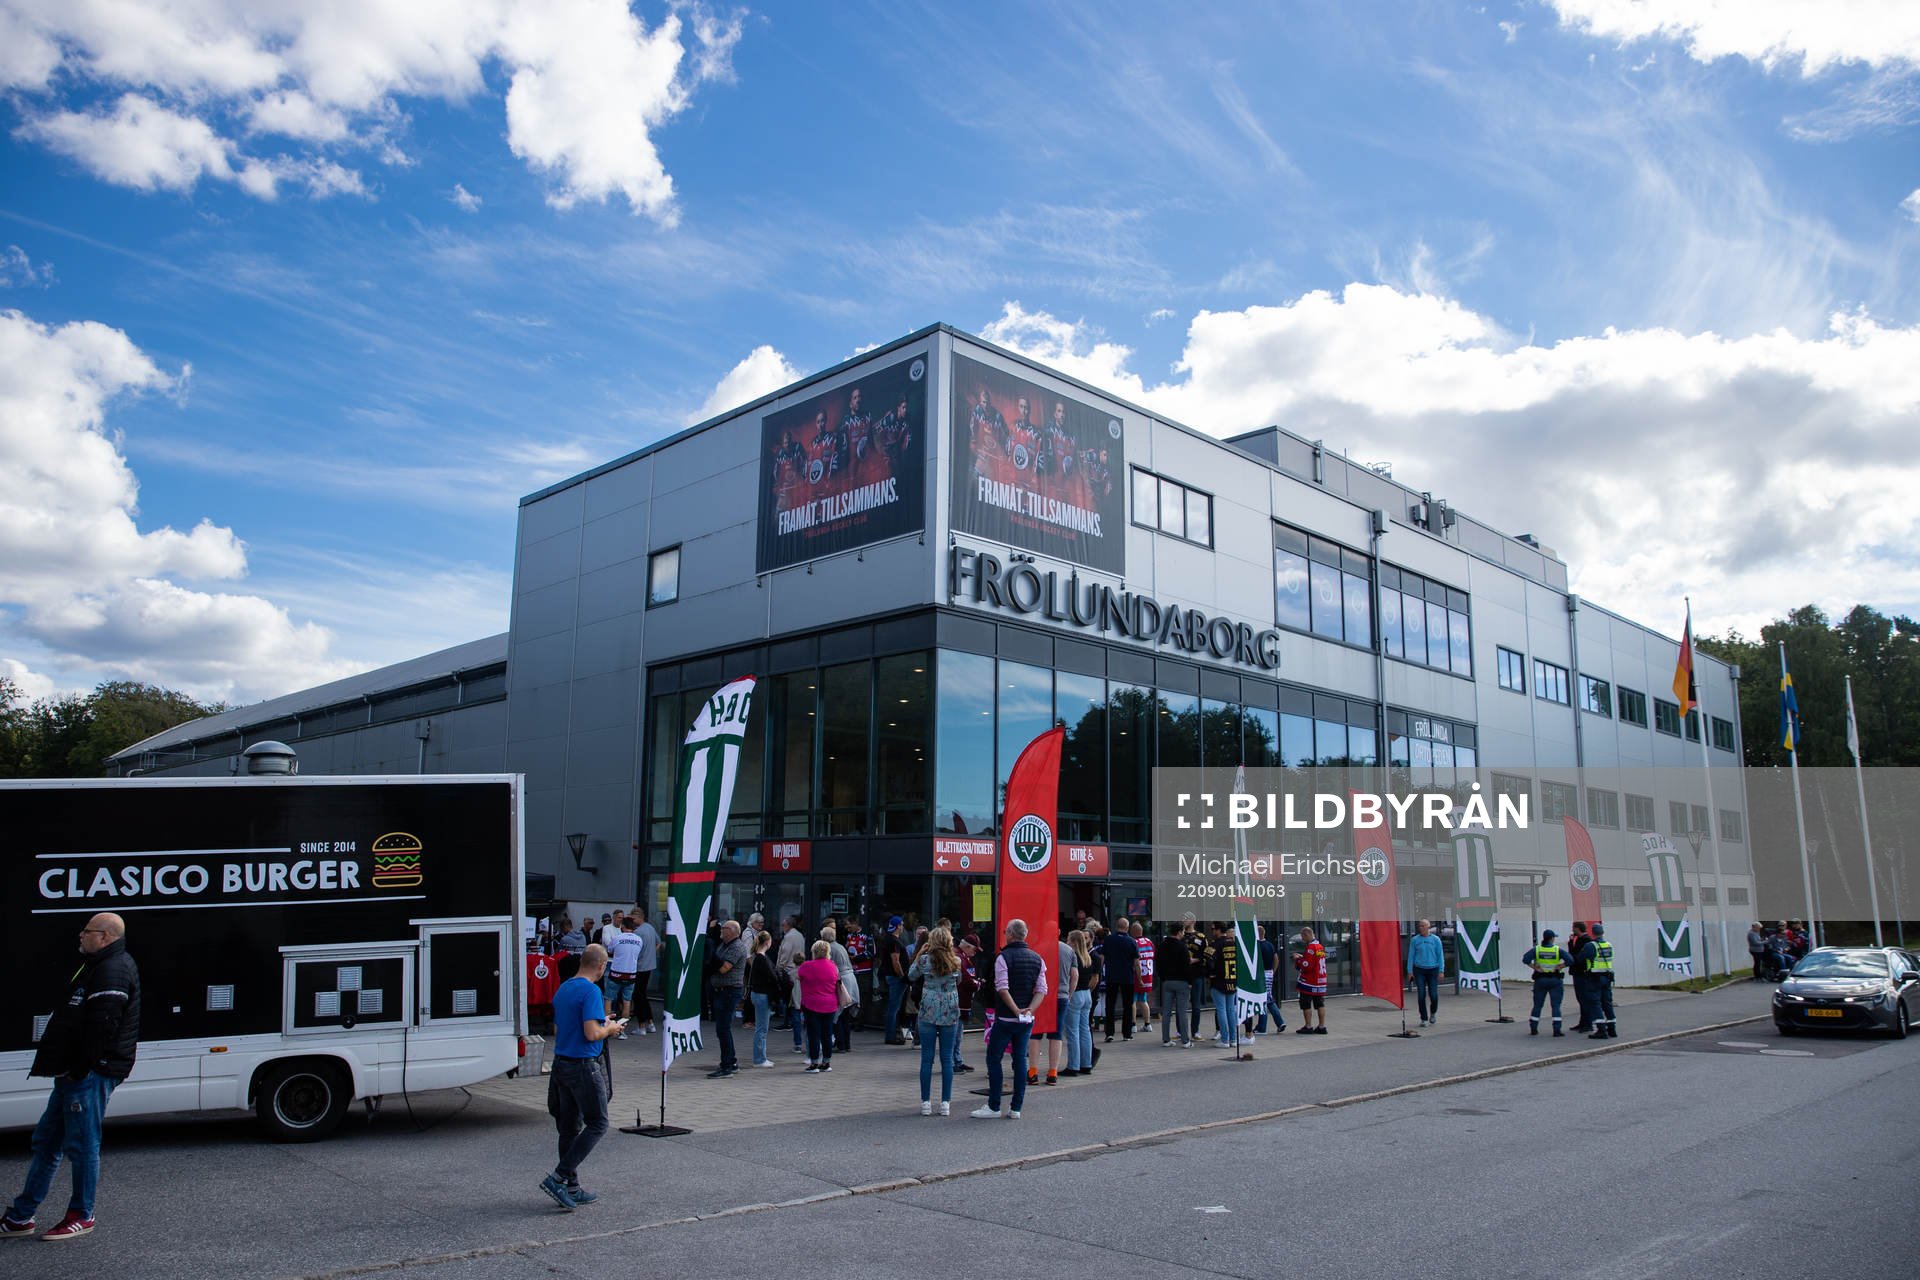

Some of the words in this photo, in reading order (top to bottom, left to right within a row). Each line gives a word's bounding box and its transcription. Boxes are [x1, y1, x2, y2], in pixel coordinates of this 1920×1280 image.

[778, 501, 819, 536] FRAMÅT.
[821, 477, 899, 523] TILLSAMMANS.
[979, 476, 1025, 514] FRAMÅT.
[1027, 492, 1103, 538] TILLSAMMANS.
[952, 546, 1281, 669] FRÖLUNDABORG
[300, 843, 330, 853] SINCE
[334, 841, 356, 852] 2014
[38, 865, 209, 899] CLASICO
[223, 860, 360, 893] BURGER
